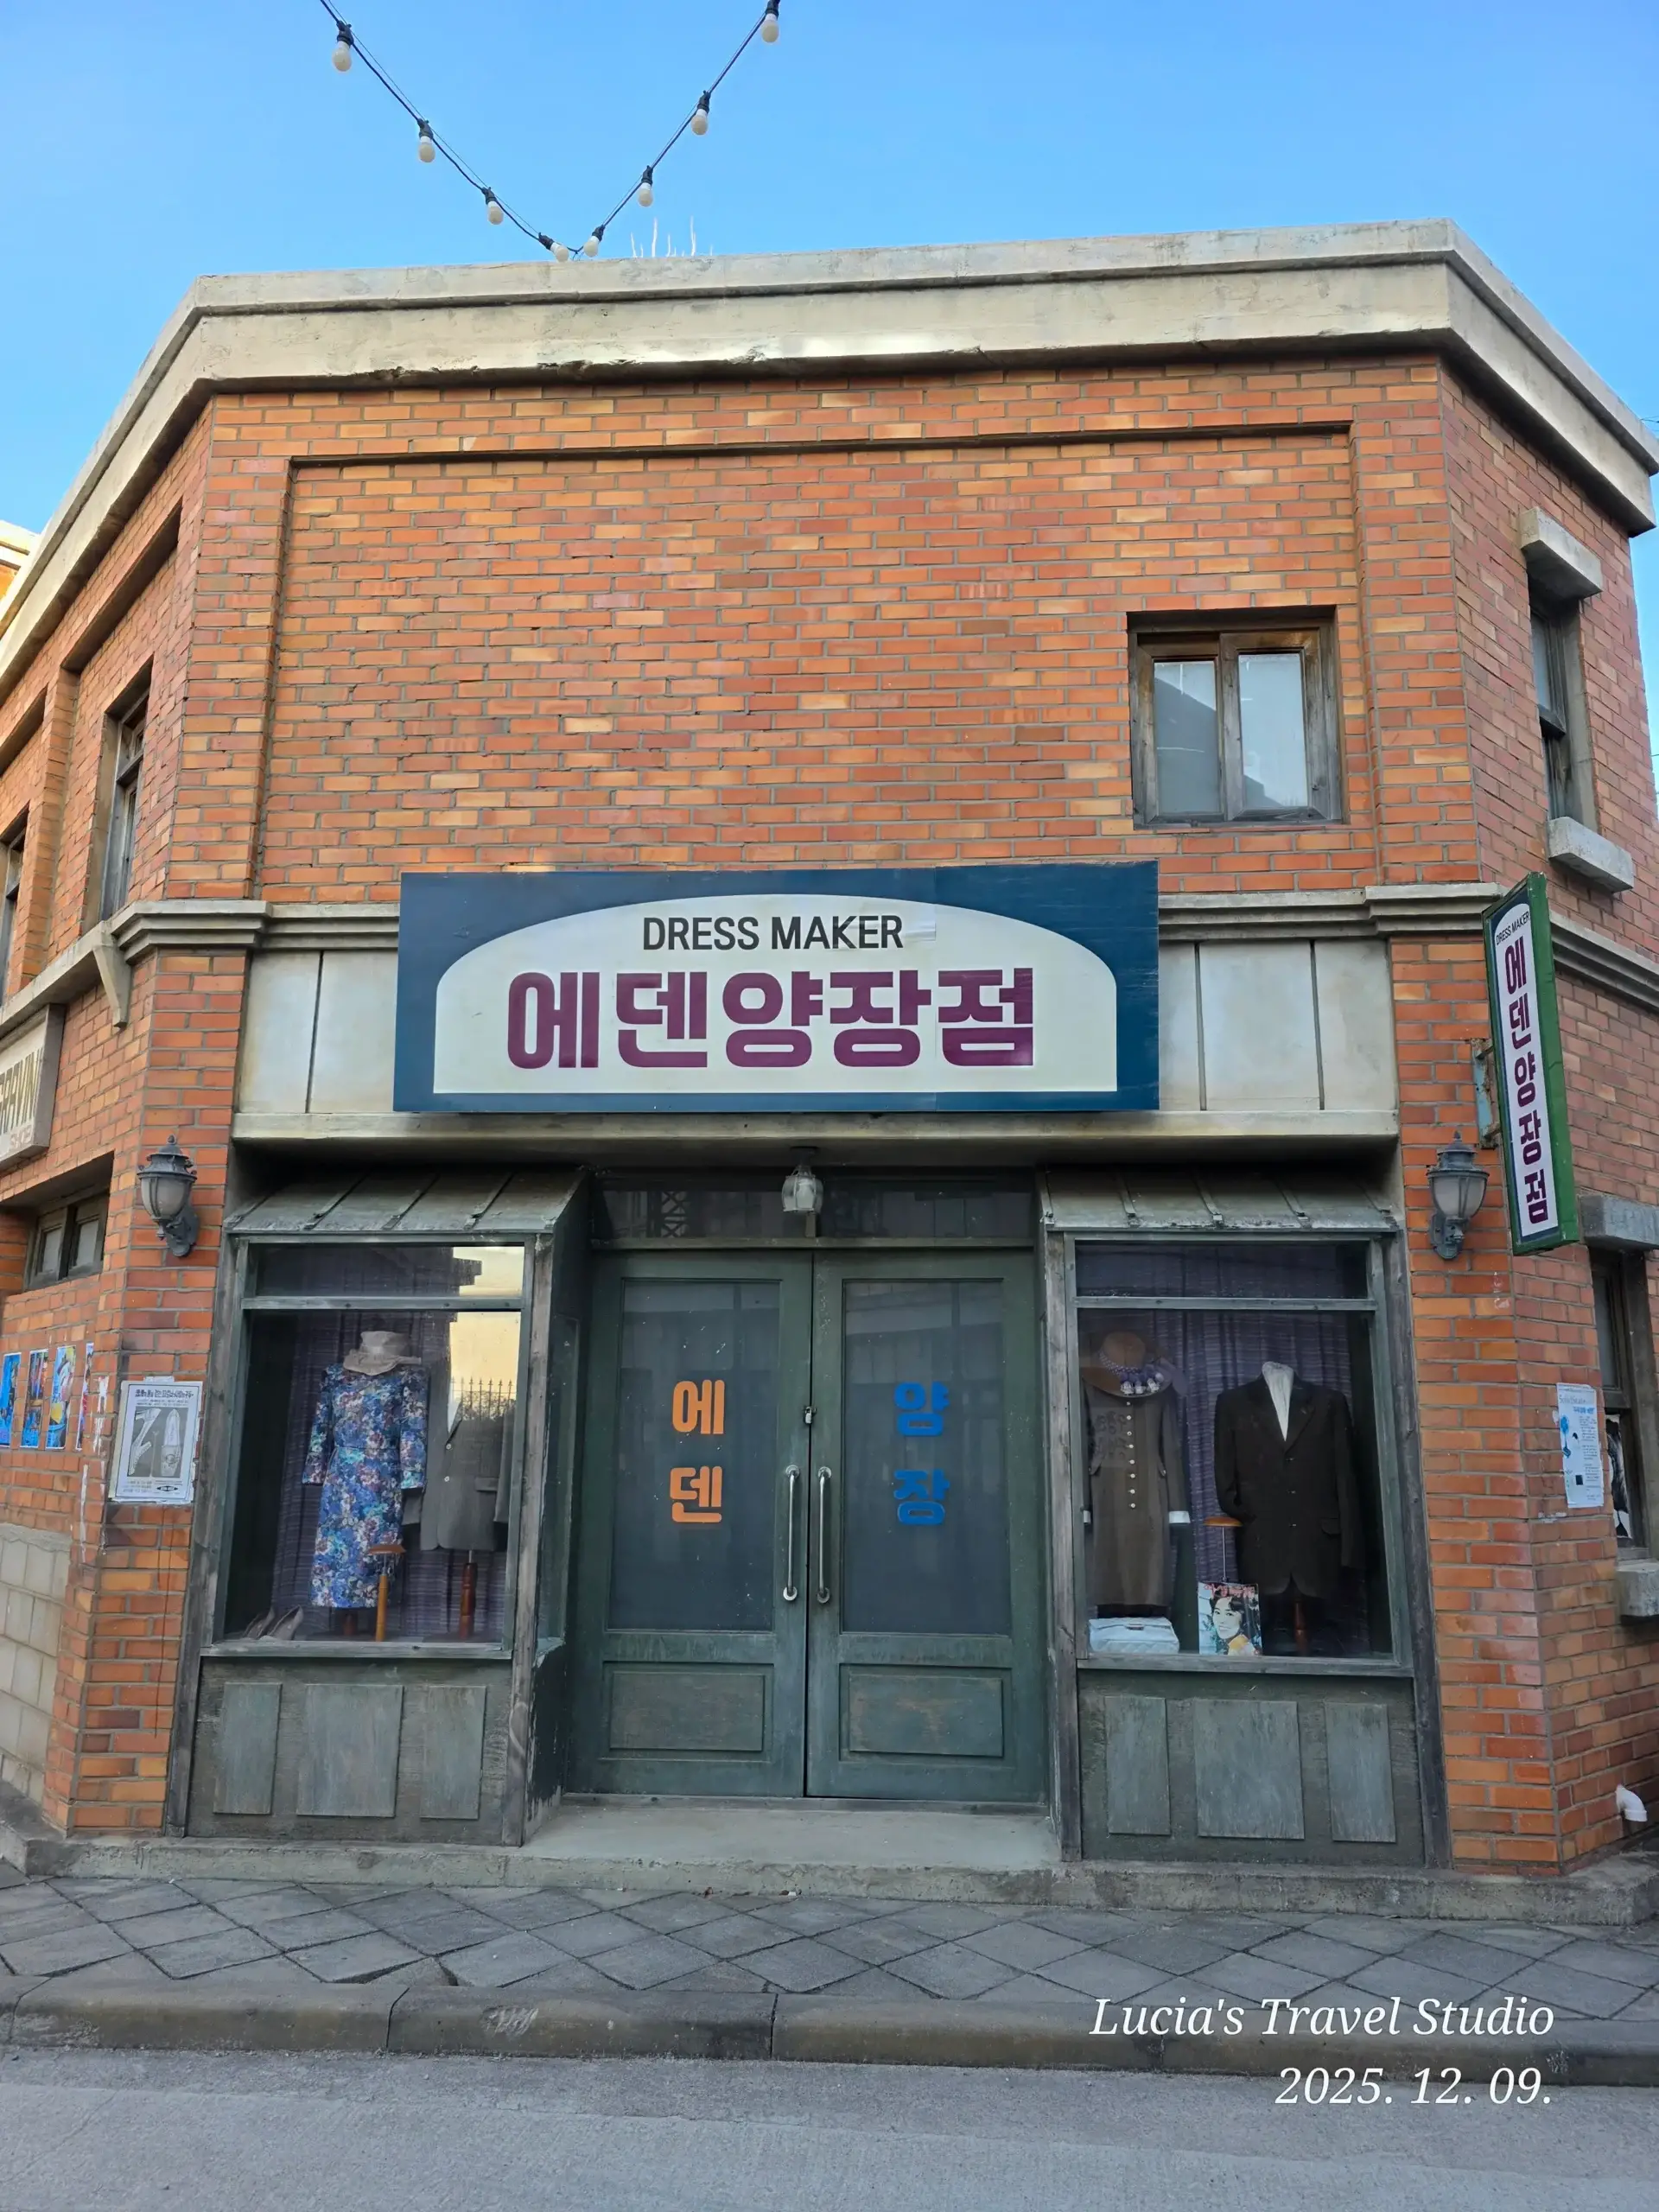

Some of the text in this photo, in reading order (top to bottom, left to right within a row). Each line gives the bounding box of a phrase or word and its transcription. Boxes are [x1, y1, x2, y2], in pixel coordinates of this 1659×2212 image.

[643, 915, 904, 951] DRESS MAKER
[1496, 911, 1530, 945] DRESS MAKER
[506, 967, 1034, 1070] 에덴양장점
[1504, 936, 1548, 1224] 에덴양장점
